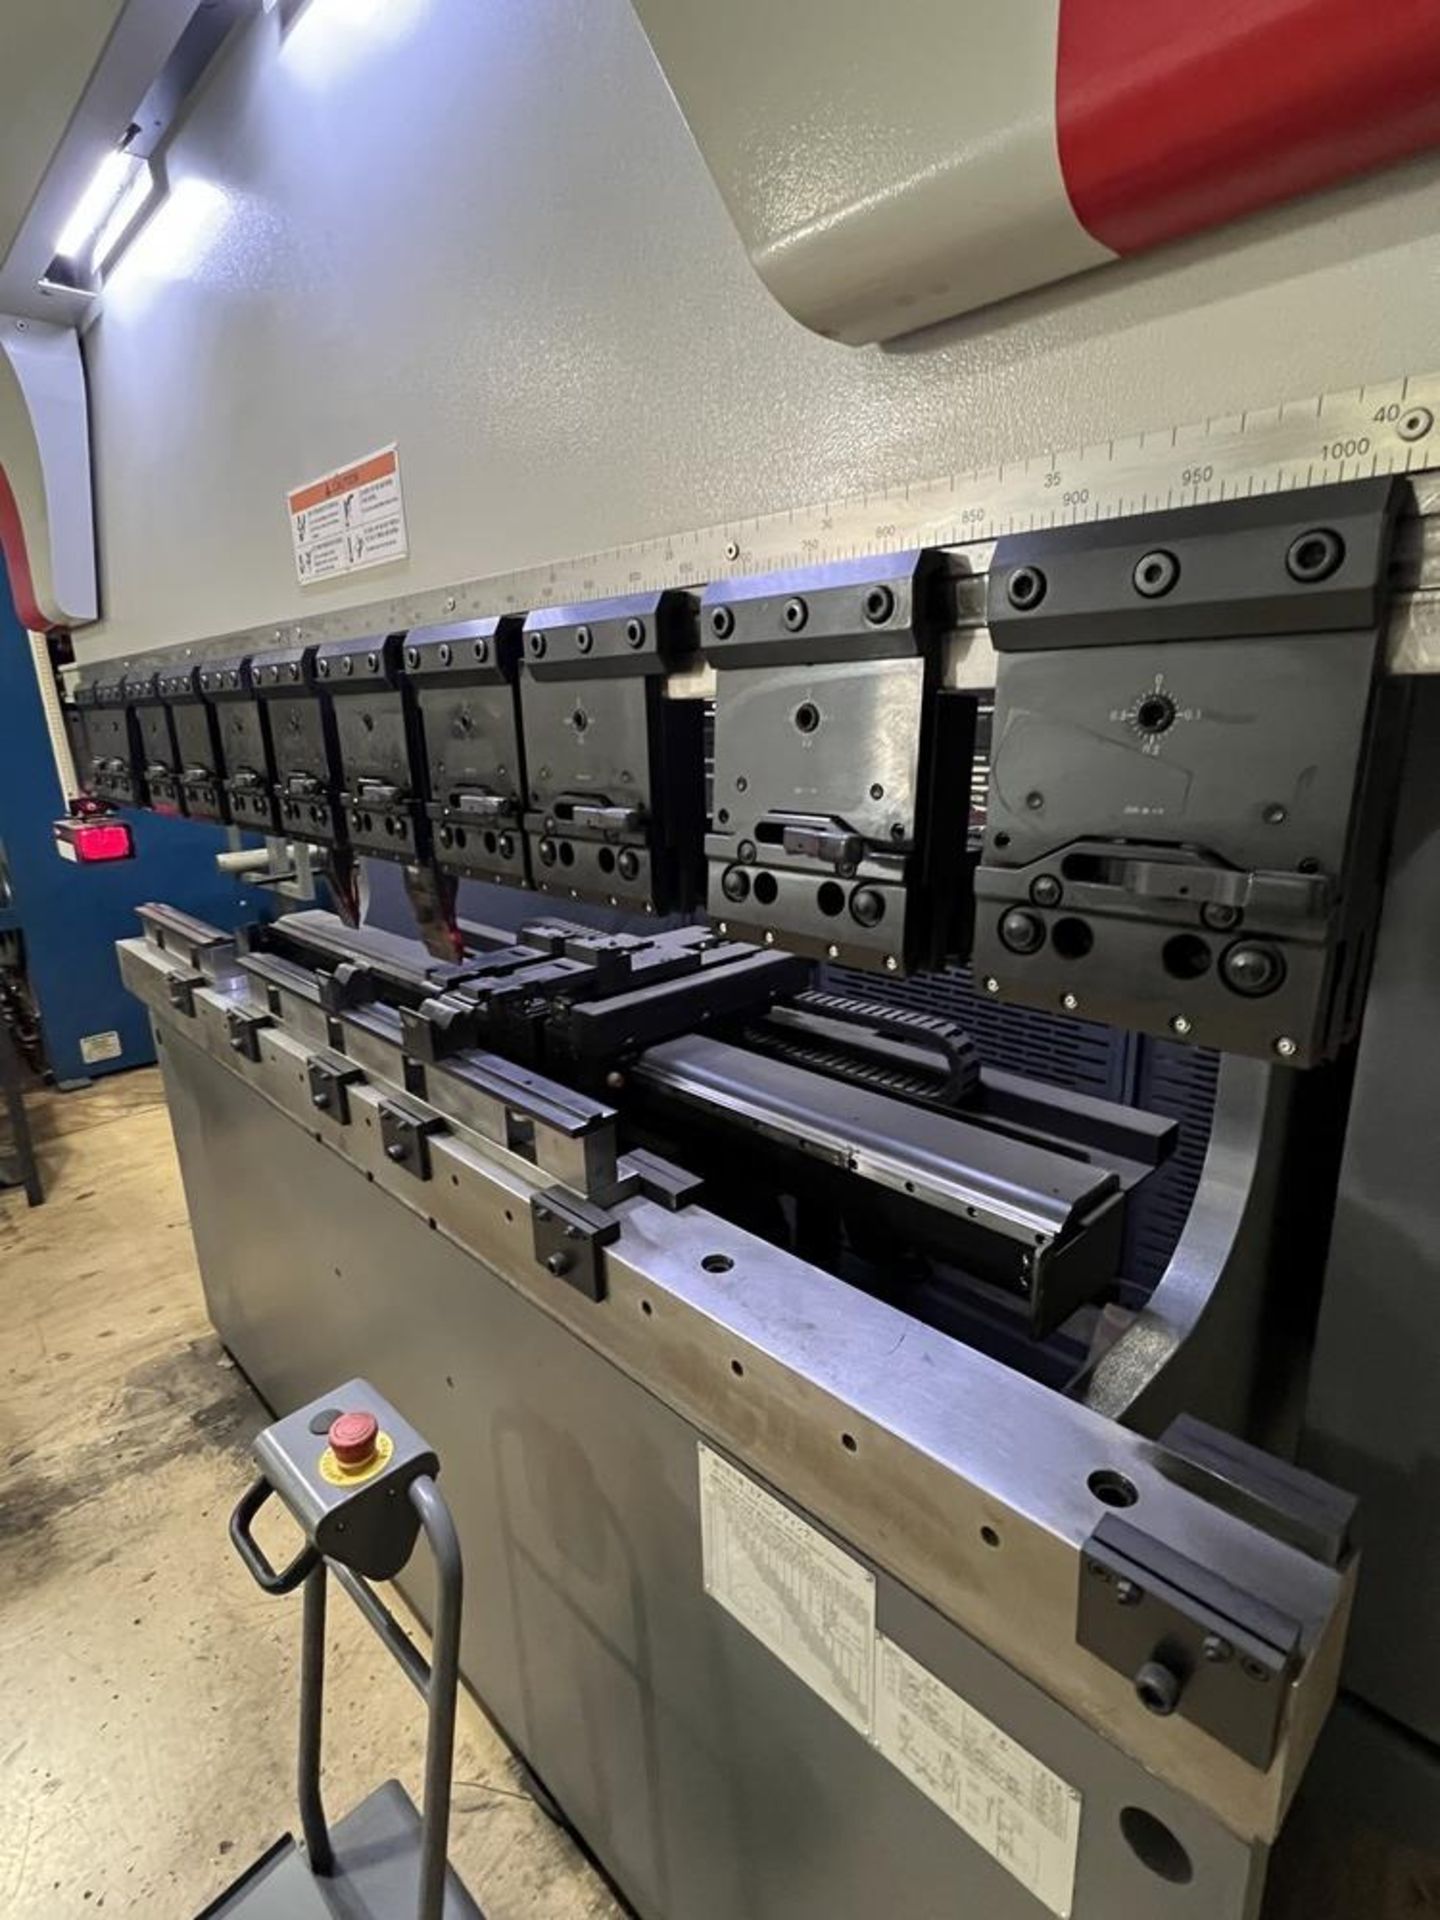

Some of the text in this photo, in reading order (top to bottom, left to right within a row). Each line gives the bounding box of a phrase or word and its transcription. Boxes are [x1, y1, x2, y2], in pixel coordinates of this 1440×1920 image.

[1373, 403, 1400, 423] 40
[1322, 437, 1370, 461] 1000
[1043, 472, 1061, 488] 35
[1182, 465, 1213, 486] 950
[1063, 489, 1089, 506] 900
